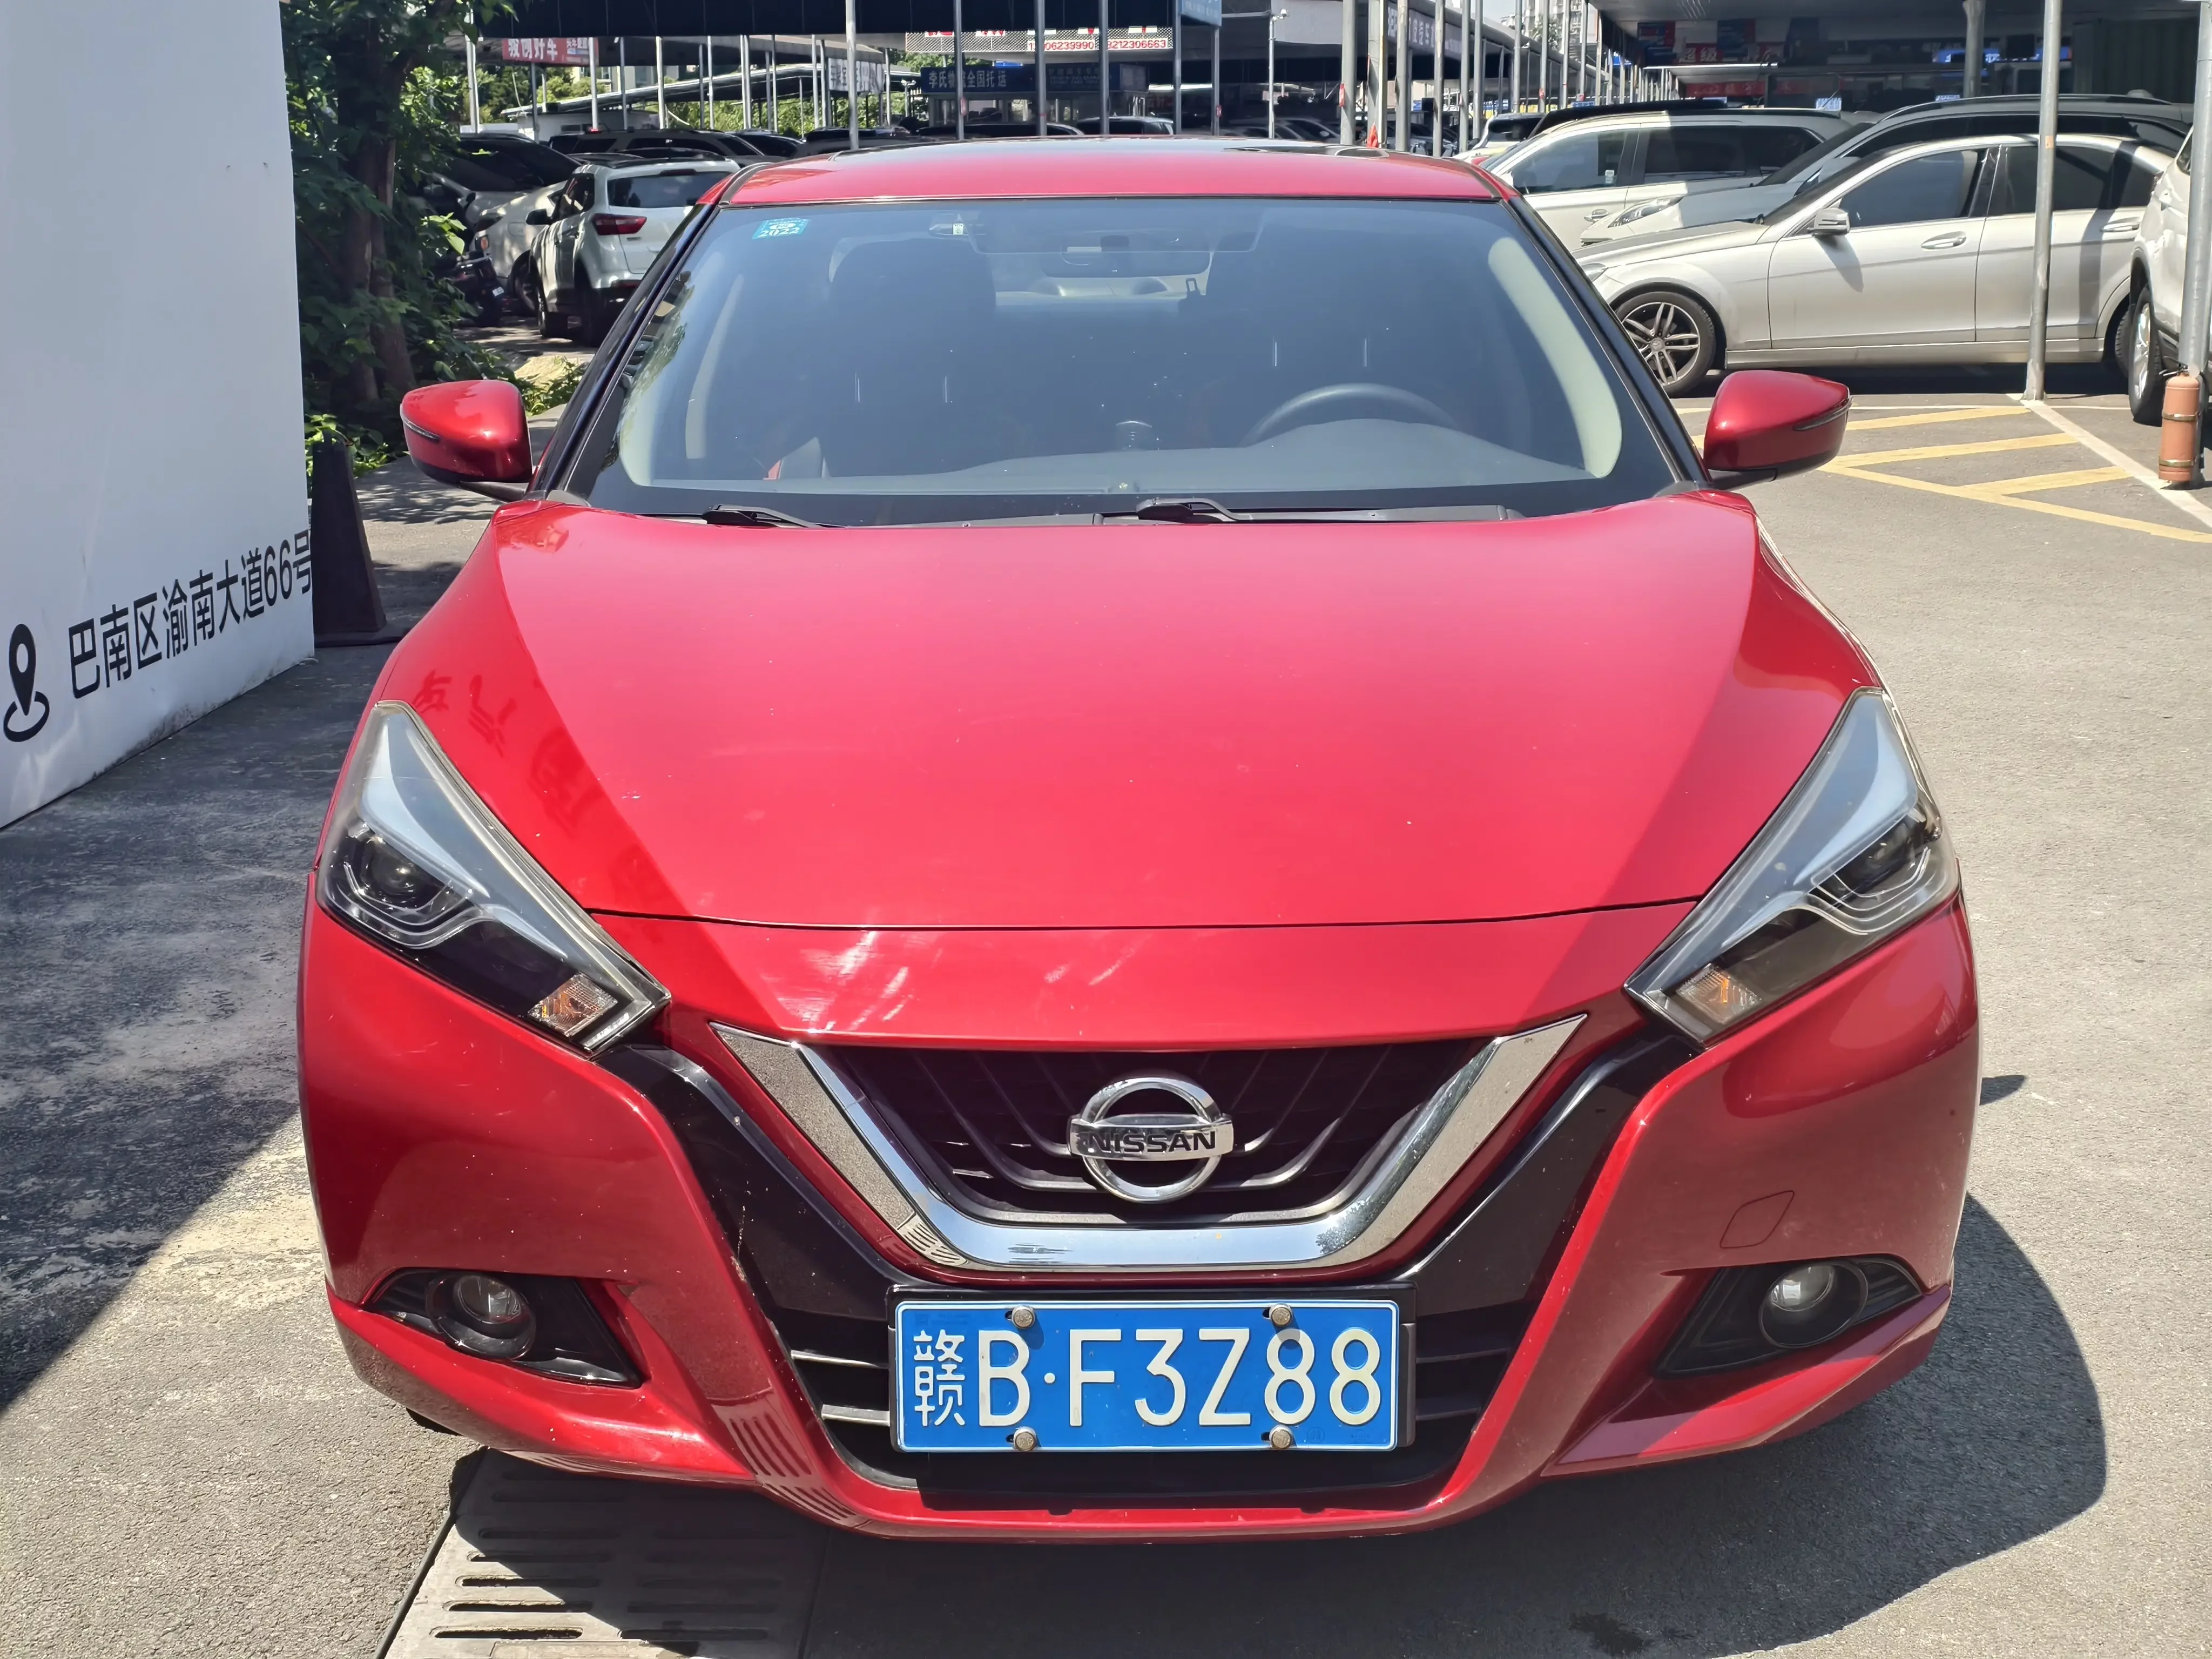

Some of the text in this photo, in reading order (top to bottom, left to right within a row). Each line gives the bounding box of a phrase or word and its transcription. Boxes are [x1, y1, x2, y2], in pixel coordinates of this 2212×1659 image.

[1028, 42, 1095, 50] 106239990
[1107, 40, 1165, 49] 8212306663
[757, 227, 800, 237] 2022
[69, 529, 312, 699] 巴南区渝南大道66号
[1088, 1130, 1216, 1153] NISSAN
[913, 1327, 1381, 1428] 赣B·F3Z88
